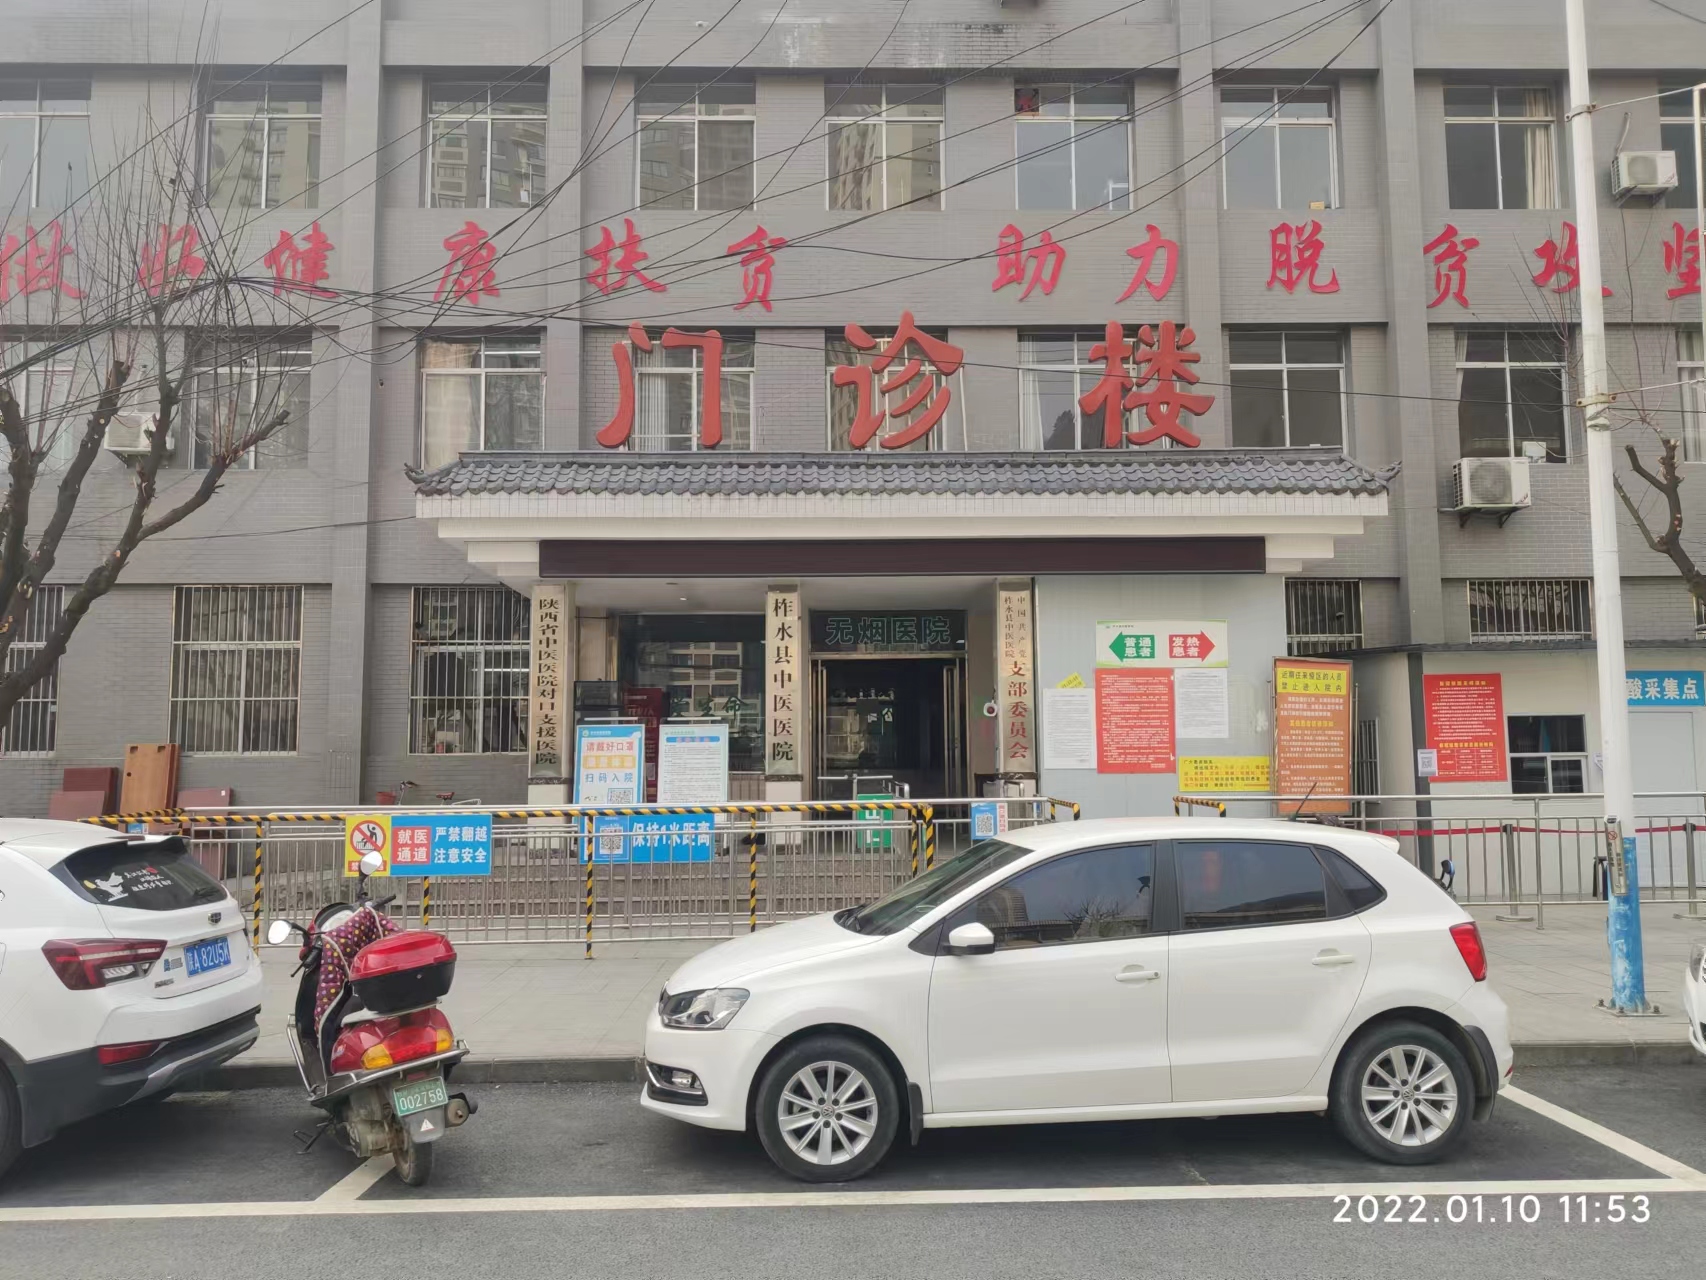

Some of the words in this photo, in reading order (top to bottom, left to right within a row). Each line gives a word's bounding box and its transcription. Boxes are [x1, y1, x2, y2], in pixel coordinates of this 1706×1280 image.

[595, 310, 1216, 450] 门诊楼
[825, 615, 951, 646] 无烟医院
[1124, 637, 1152, 647] 普通
[1172, 637, 1200, 647] 发热
[1124, 647, 1153, 657] 患者
[1172, 647, 1200, 657] 患者
[535, 598, 560, 765] 陕西省中医医院对口支援医院
[771, 598, 794, 761] 柞水县中医医院
[1007, 660, 1030, 759] 支部委员会
[585, 772, 633, 783] 扫码入院
[397, 829, 428, 844] 就医
[434, 826, 487, 842] 严禁翻越
[632, 821, 711, 847] 保持1米距离
[397, 847, 428, 862] 通道
[434, 848, 487, 863] 注意安全
[399, 1088, 444, 1111] 002758
